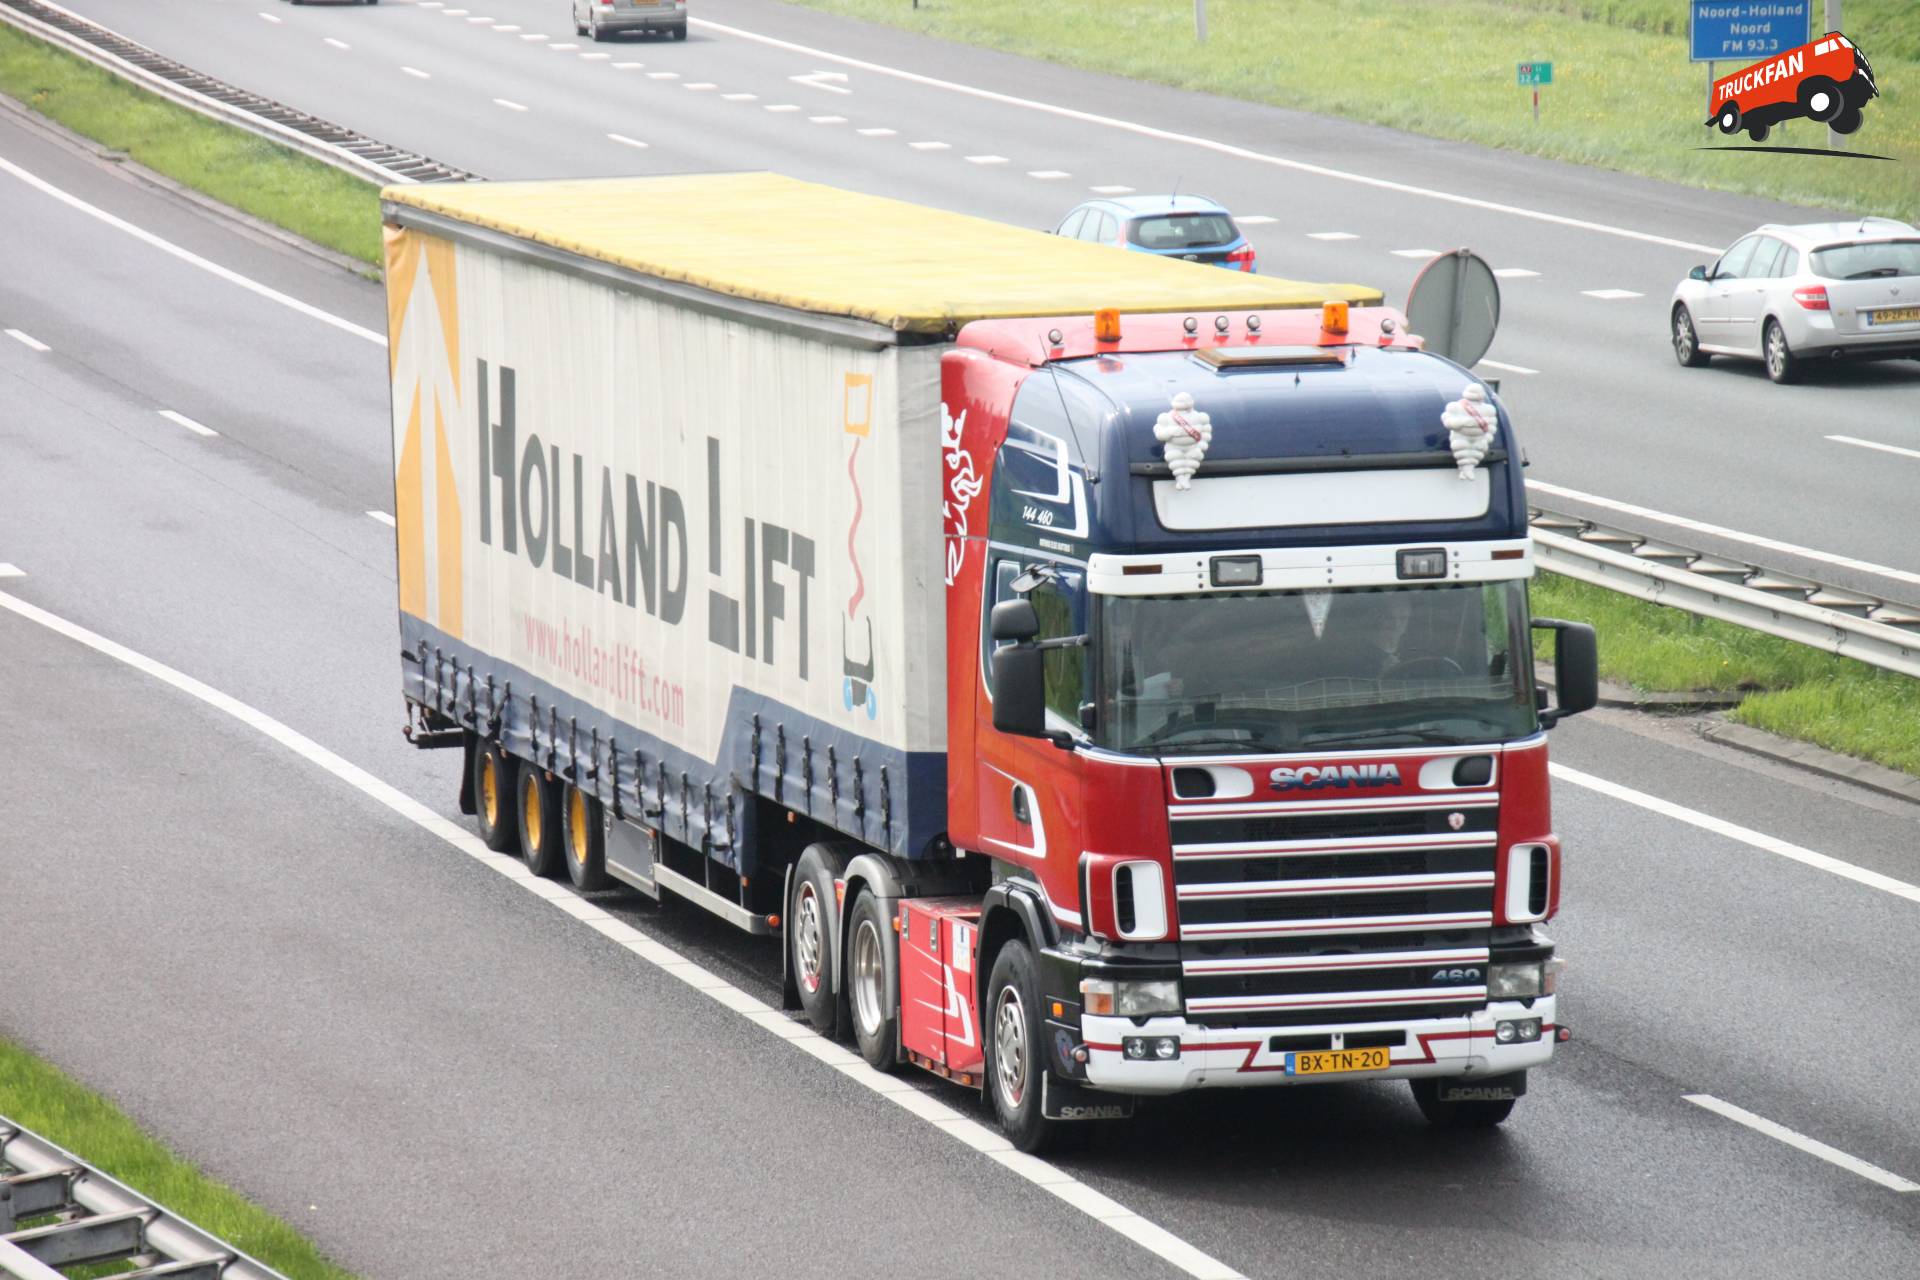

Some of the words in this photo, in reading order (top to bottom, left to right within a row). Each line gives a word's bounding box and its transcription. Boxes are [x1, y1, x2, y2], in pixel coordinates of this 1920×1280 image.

[1699, 4, 1803, 18] Noord-Holland
[1730, 22, 1771, 35] Noord
[1722, 40, 1744, 52] FM
[1747, 38, 1779, 51] 93.3
[476, 357, 688, 626] HOLLAND
[706, 435, 816, 682] LIFT
[1022, 505, 1037, 522] 144
[1037, 509, 1054, 526] 460
[524, 612, 685, 728] www.hollandlift.com
[1269, 763, 1402, 791] SCANIA
[1432, 968, 1481, 982] 460
[1300, 1051, 1384, 1072] BX-TN-20
[1447, 1087, 1515, 1100] SCANIA
[1060, 1106, 1122, 1118] SCANIA
